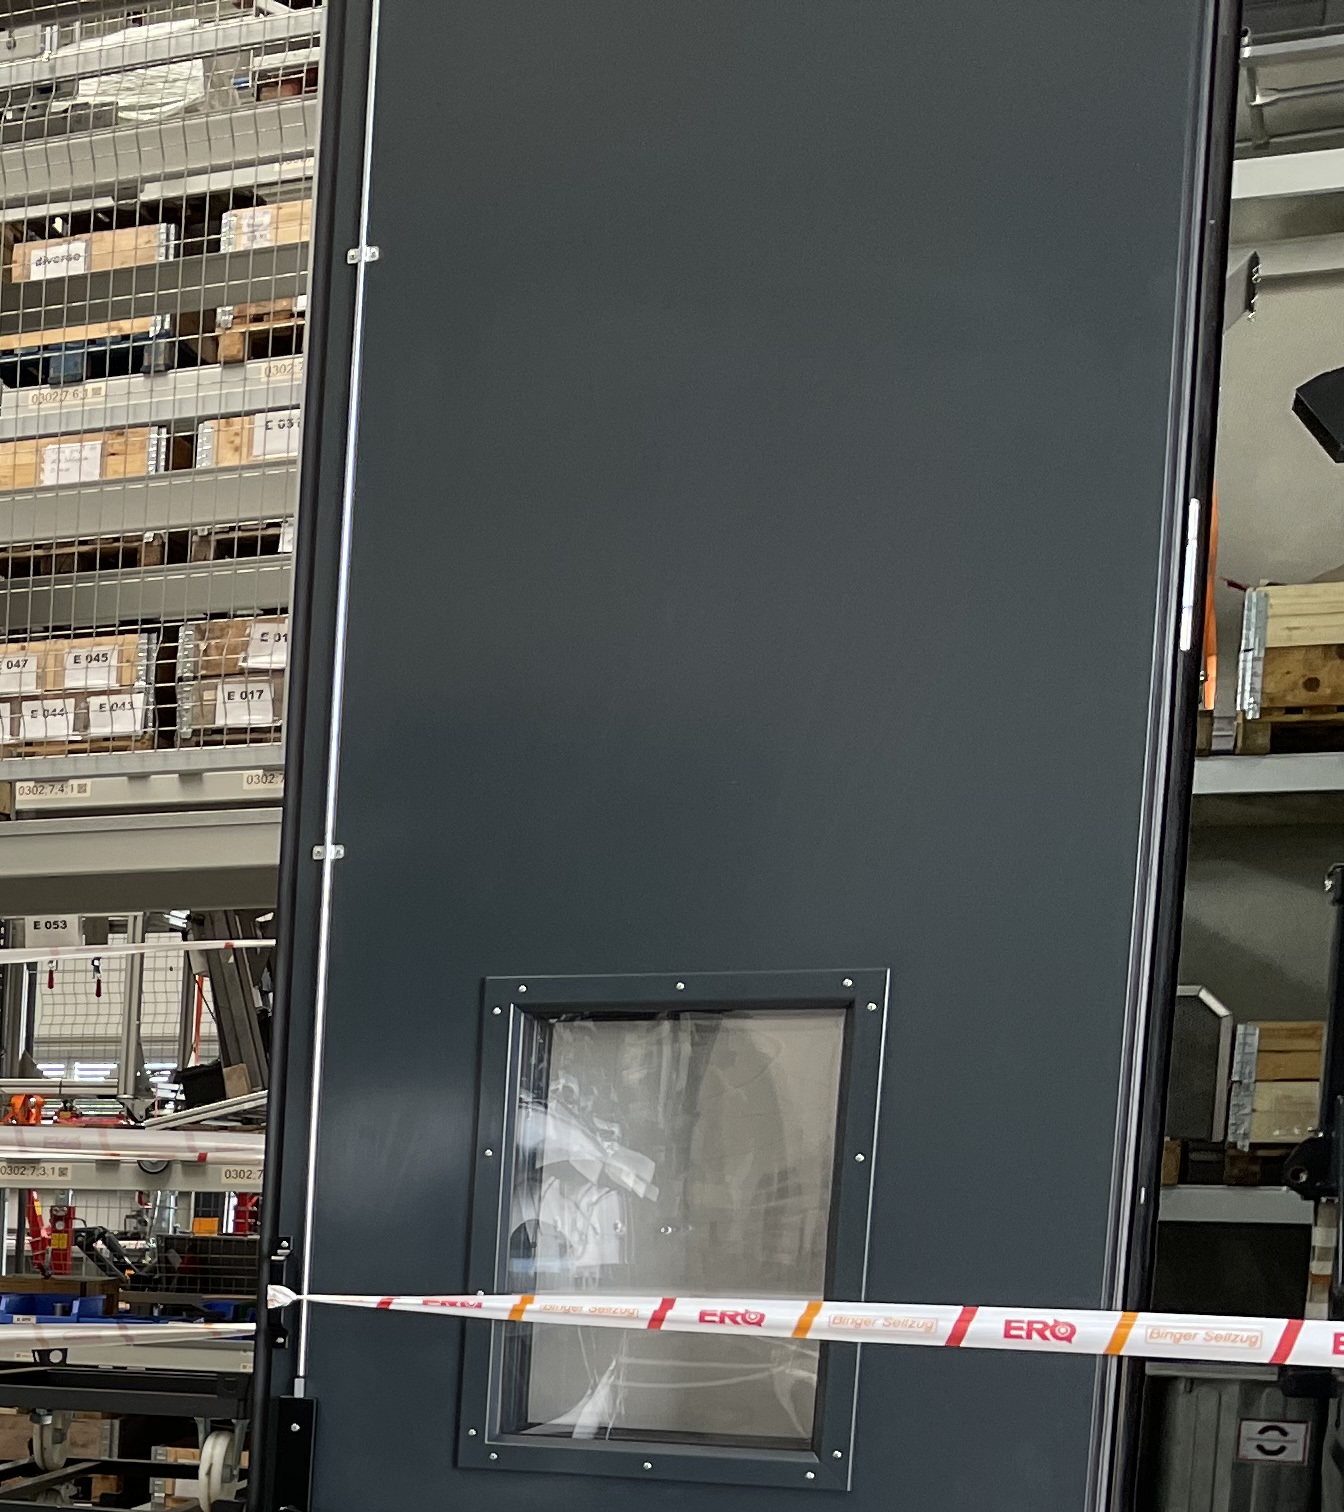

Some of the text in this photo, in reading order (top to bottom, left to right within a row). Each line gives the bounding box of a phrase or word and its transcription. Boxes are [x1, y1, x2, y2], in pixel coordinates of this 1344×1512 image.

[265, 419, 274, 431] E
[260, 631, 270, 642] E
[6, 658, 29, 670] 047
[74, 652, 109, 664] E 045
[227, 689, 264, 701] E 017
[99, 702, 107, 712] E
[30, 709, 38, 719] E
[33, 919, 68, 931] E 053
[832, 1314, 877, 1329] Binger
[882, 1315, 935, 1332] Seilzug
[1149, 1328, 1199, 1344] Binger
[1204, 1330, 1261, 1348] Seilzug
